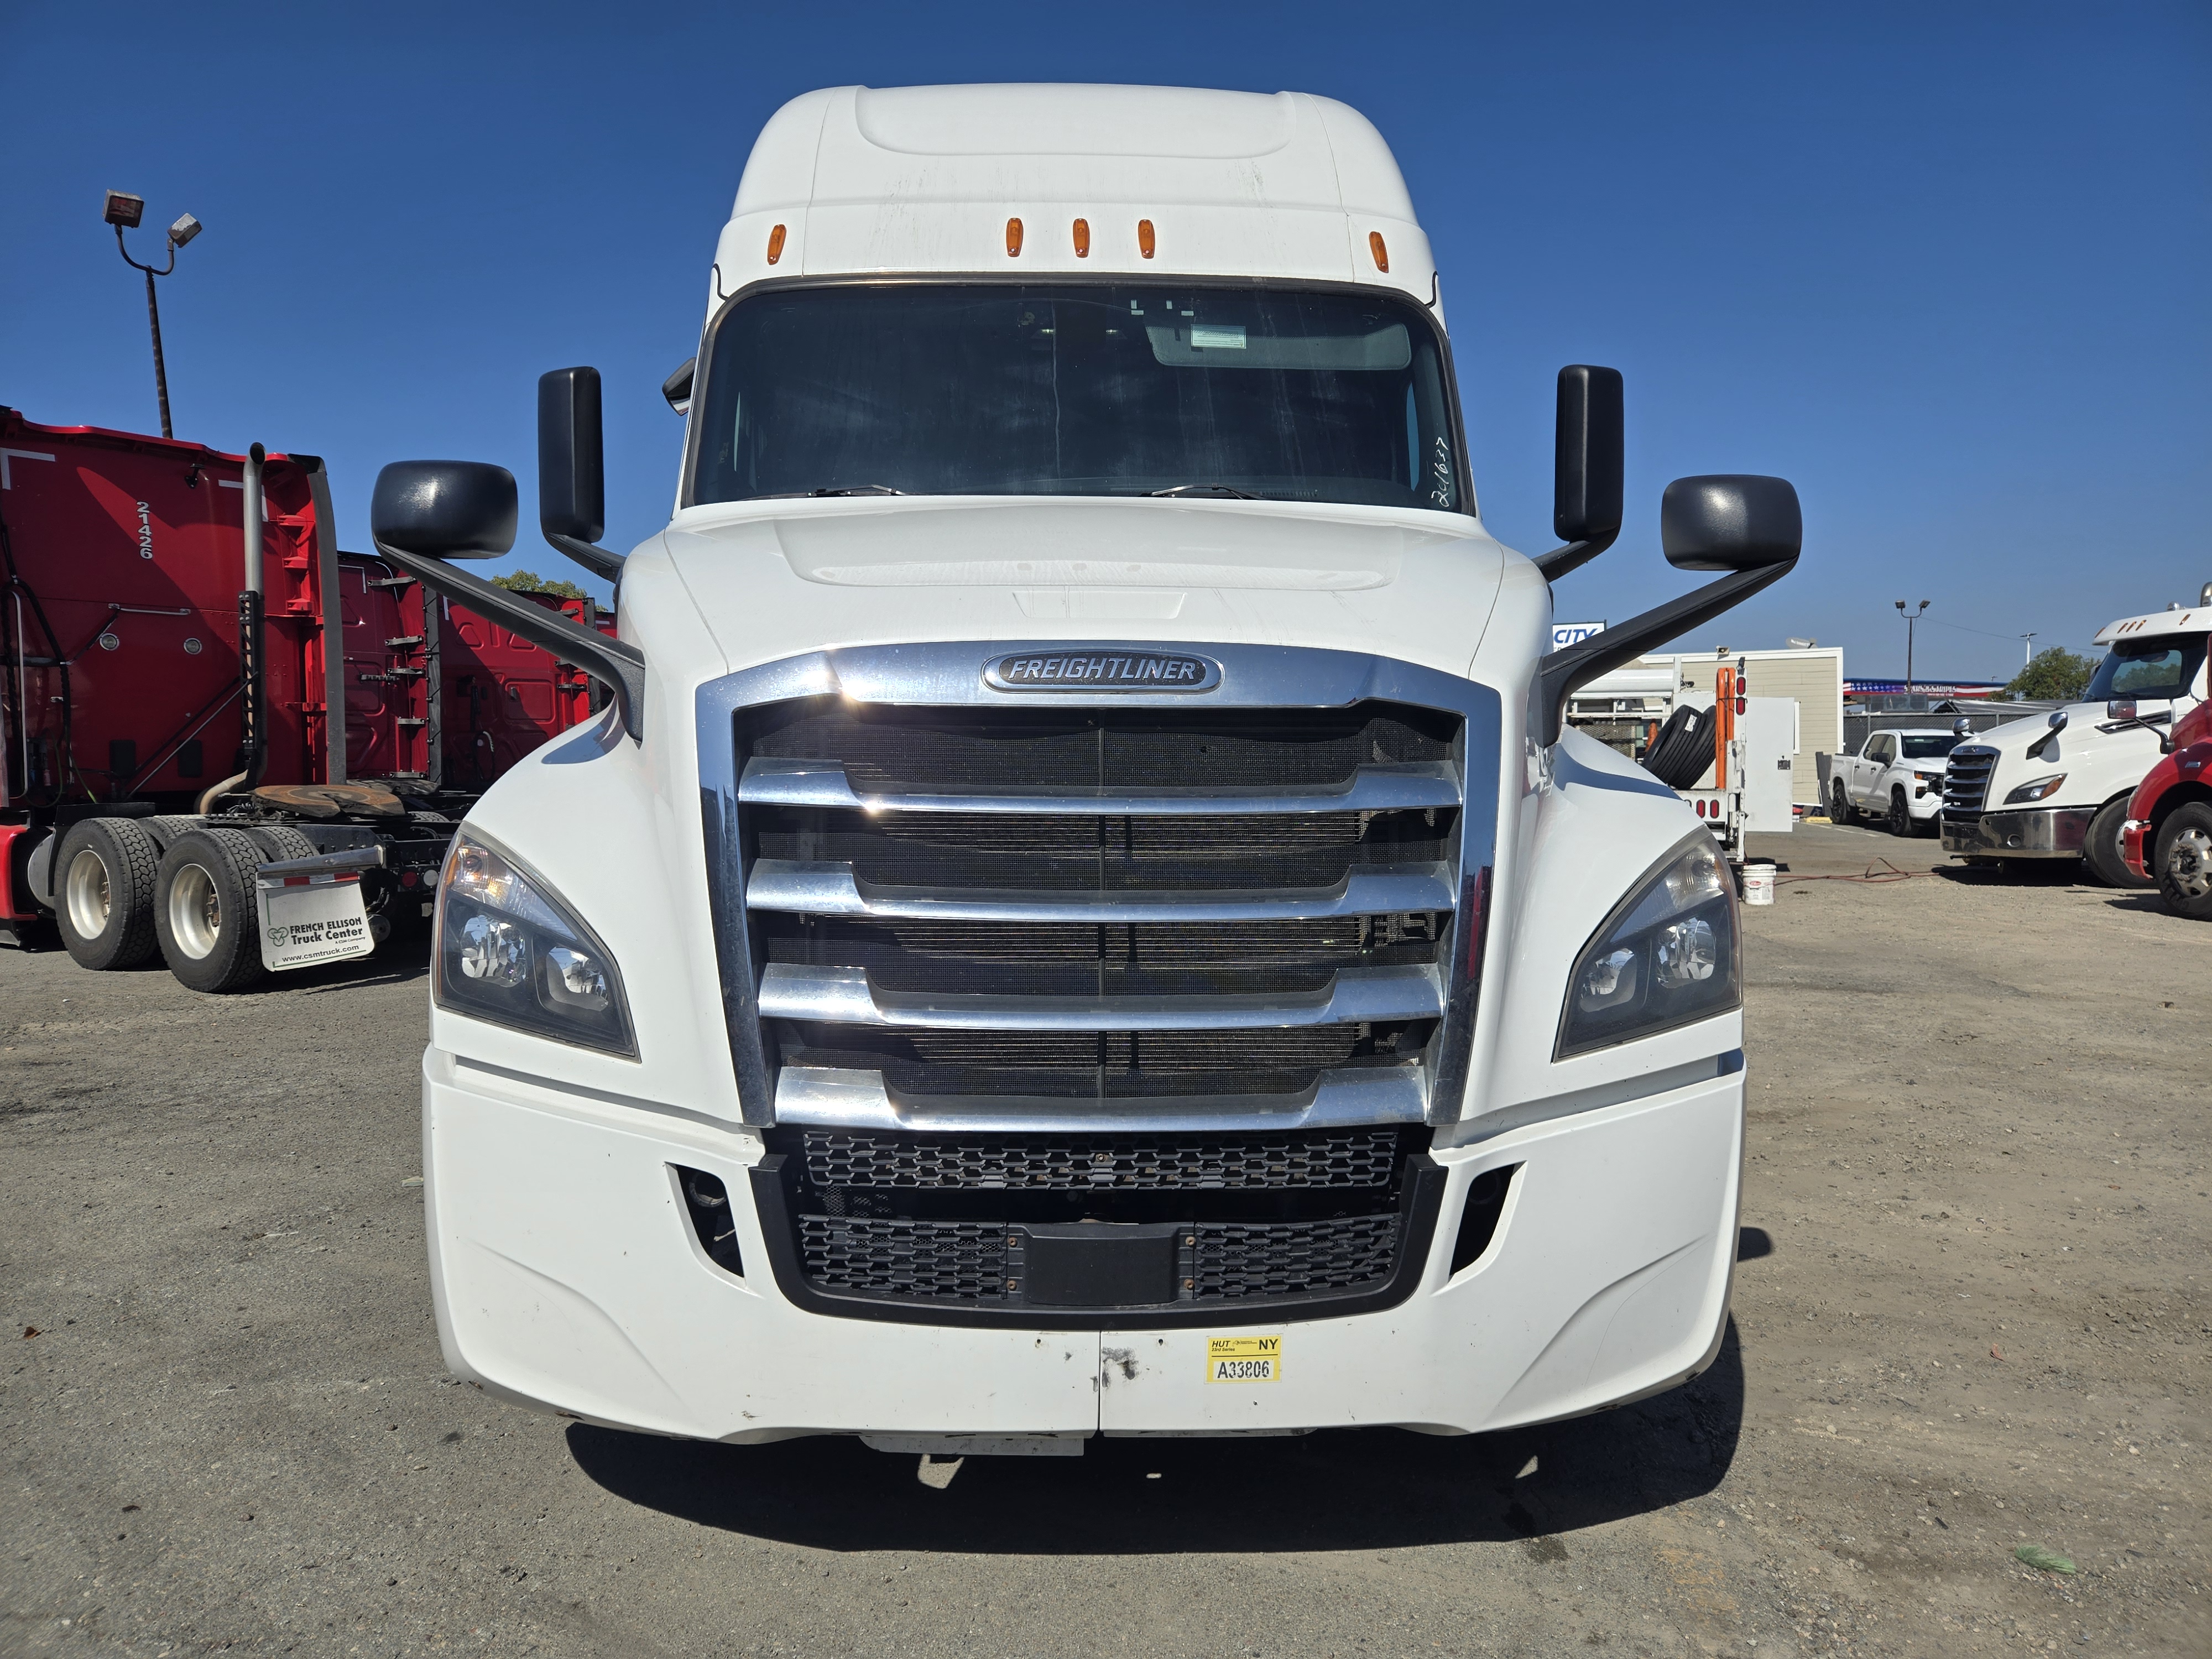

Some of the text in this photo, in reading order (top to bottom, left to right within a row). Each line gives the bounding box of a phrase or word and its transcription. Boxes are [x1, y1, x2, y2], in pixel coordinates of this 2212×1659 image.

[136, 501, 153, 559] 21426
[1008, 657, 1197, 680] FREIGHTLINER
[289, 916, 362, 935] FRENCH ELLISON
[291, 927, 363, 945] Truck Center
[282, 945, 359, 962] www.csmtruck.com
[1259, 1338, 1279, 1350] NY
[1217, 1360, 1270, 1379] A33806
